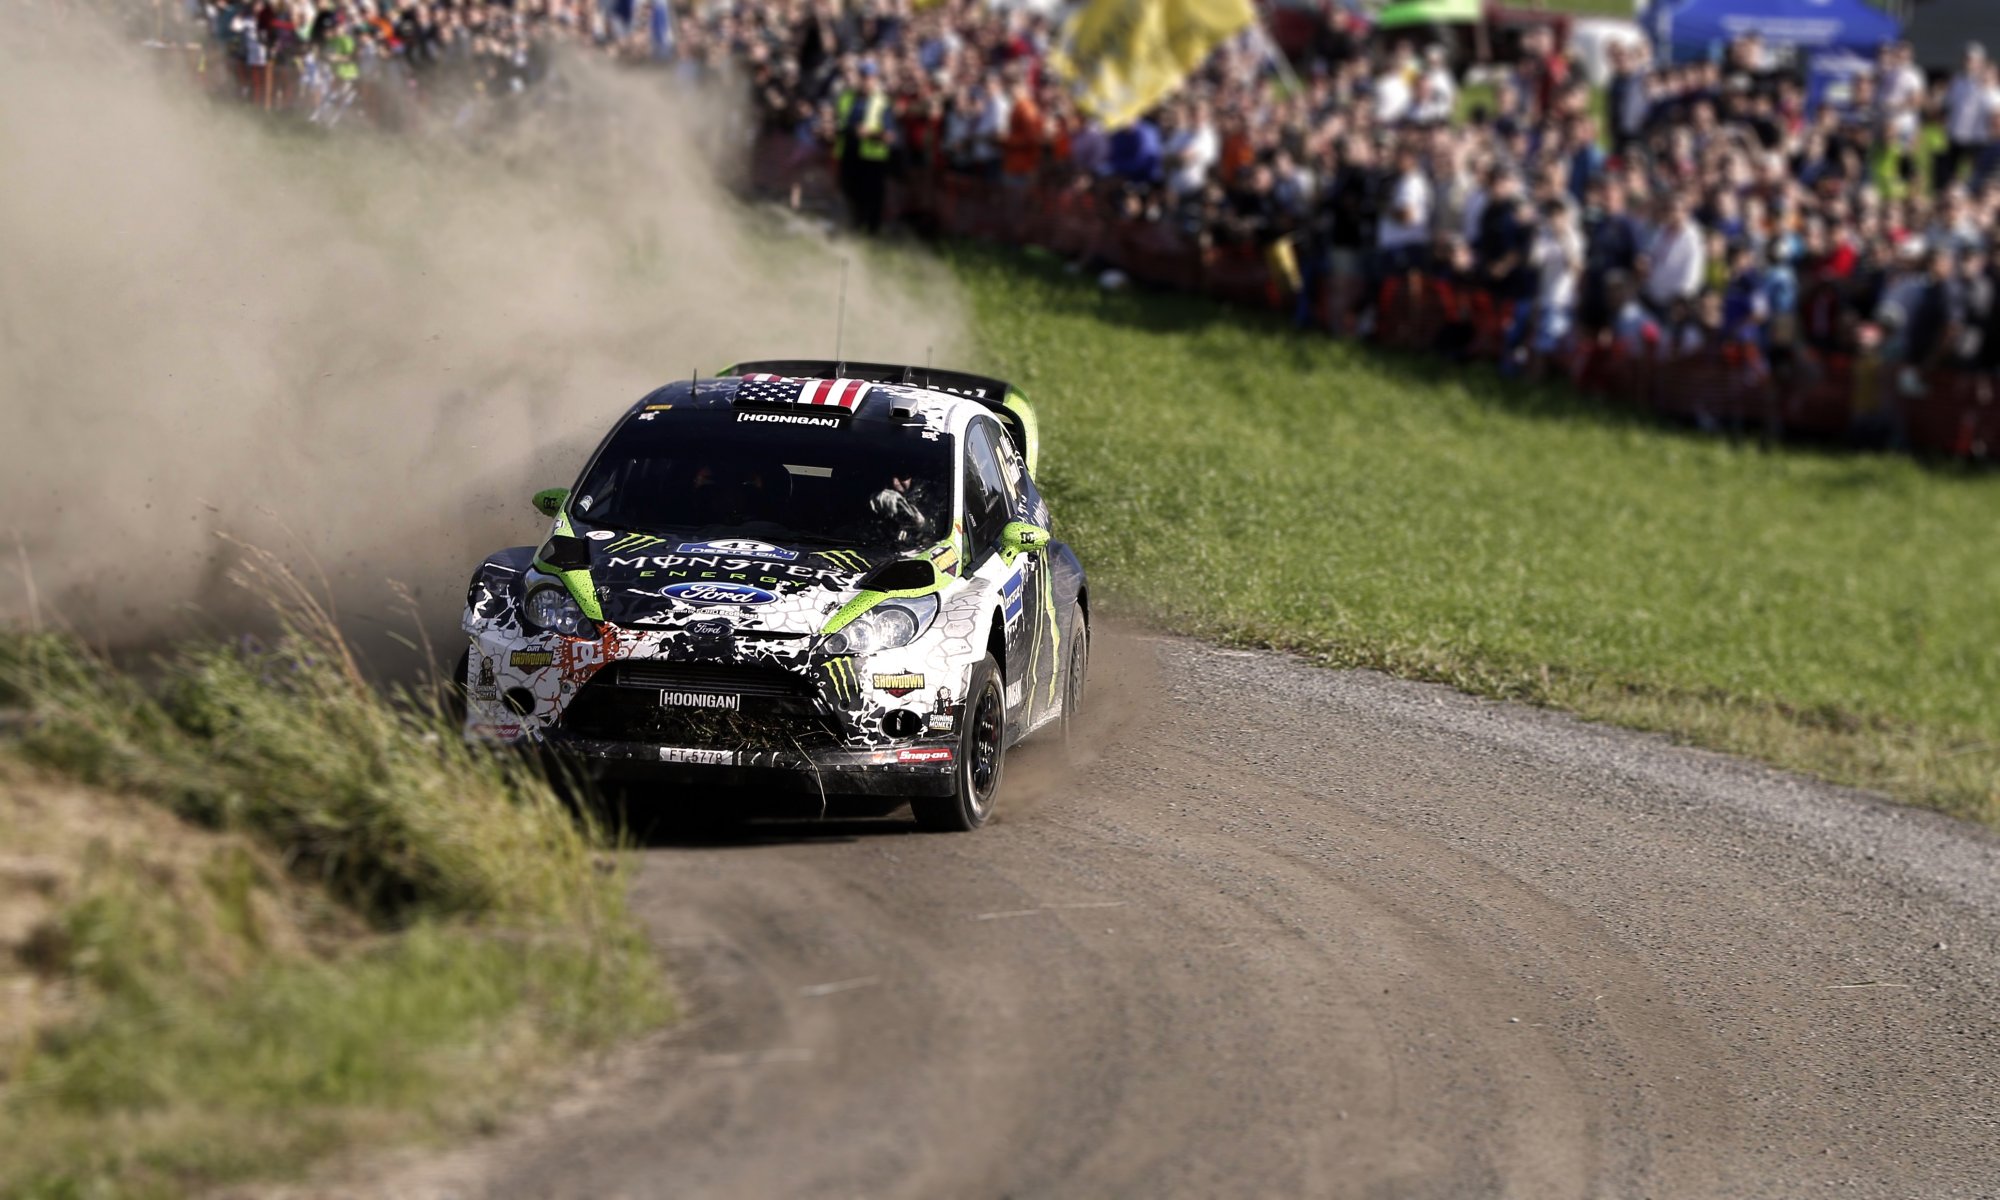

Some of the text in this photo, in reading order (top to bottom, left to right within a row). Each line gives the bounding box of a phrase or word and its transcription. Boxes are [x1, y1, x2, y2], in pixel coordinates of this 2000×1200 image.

[737, 412, 840, 428] [HOONIGAN]
[607, 554, 849, 587] MONSTER
[639, 570, 807, 588] ENERGY
[680, 584, 758, 603] Ford
[693, 622, 722, 635] Ford
[511, 652, 552, 666] SHOWDOWN
[874, 673, 924, 689] SHOWDOWN
[660, 689, 741, 711] [HOONIGAN]
[929, 721, 953, 730] MONKEY
[930, 714, 954, 722] SHINING
[898, 750, 950, 761] Snap-on
